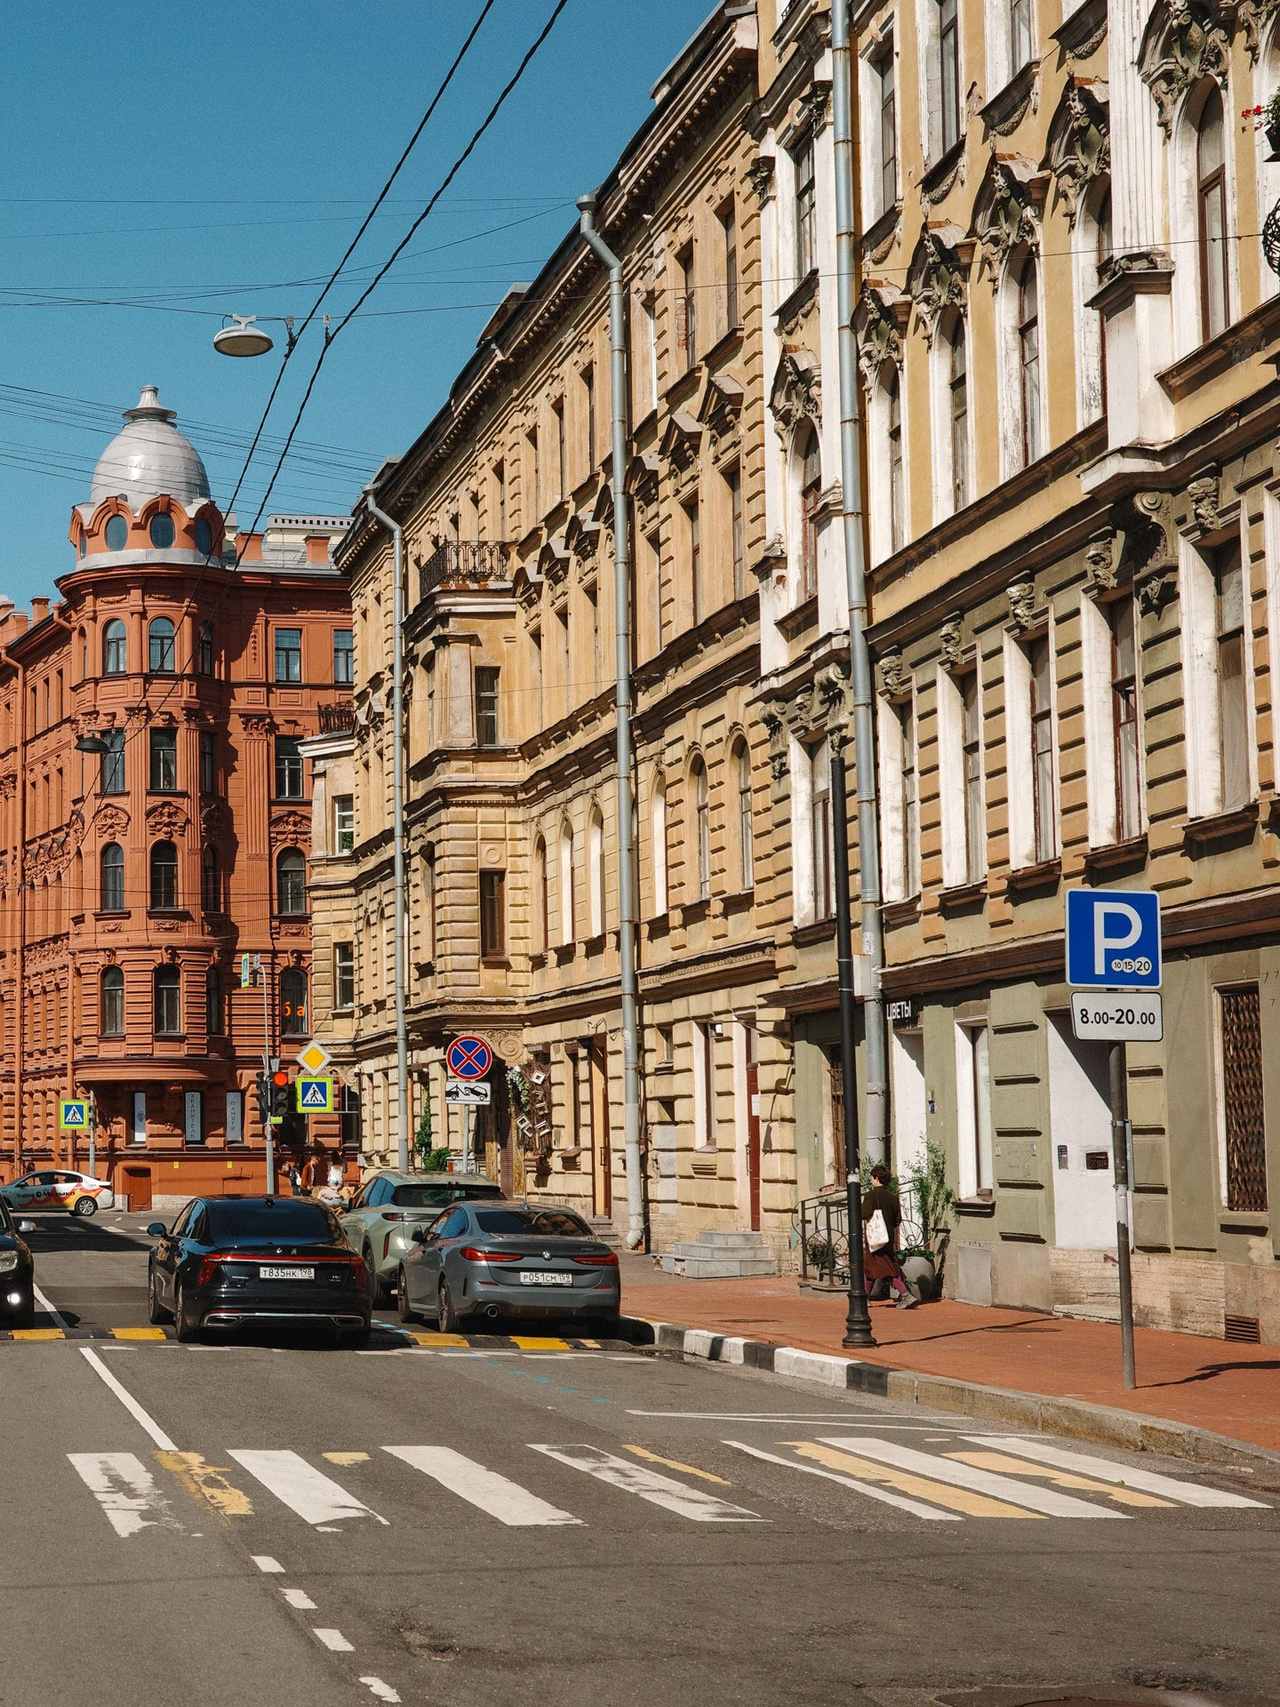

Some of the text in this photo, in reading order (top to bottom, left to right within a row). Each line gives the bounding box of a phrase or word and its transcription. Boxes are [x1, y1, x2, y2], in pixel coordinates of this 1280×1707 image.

[1093, 901, 1143, 975] P
[1114, 961, 1150, 972] 10 15 20
[886, 1000, 912, 1021] ЦВЕТЫ
[1079, 1008, 1156, 1025] 8.00-20.00
[263, 1267, 312, 1277] Т835НК 198
[523, 1273, 557, 1282] Р051СМ
